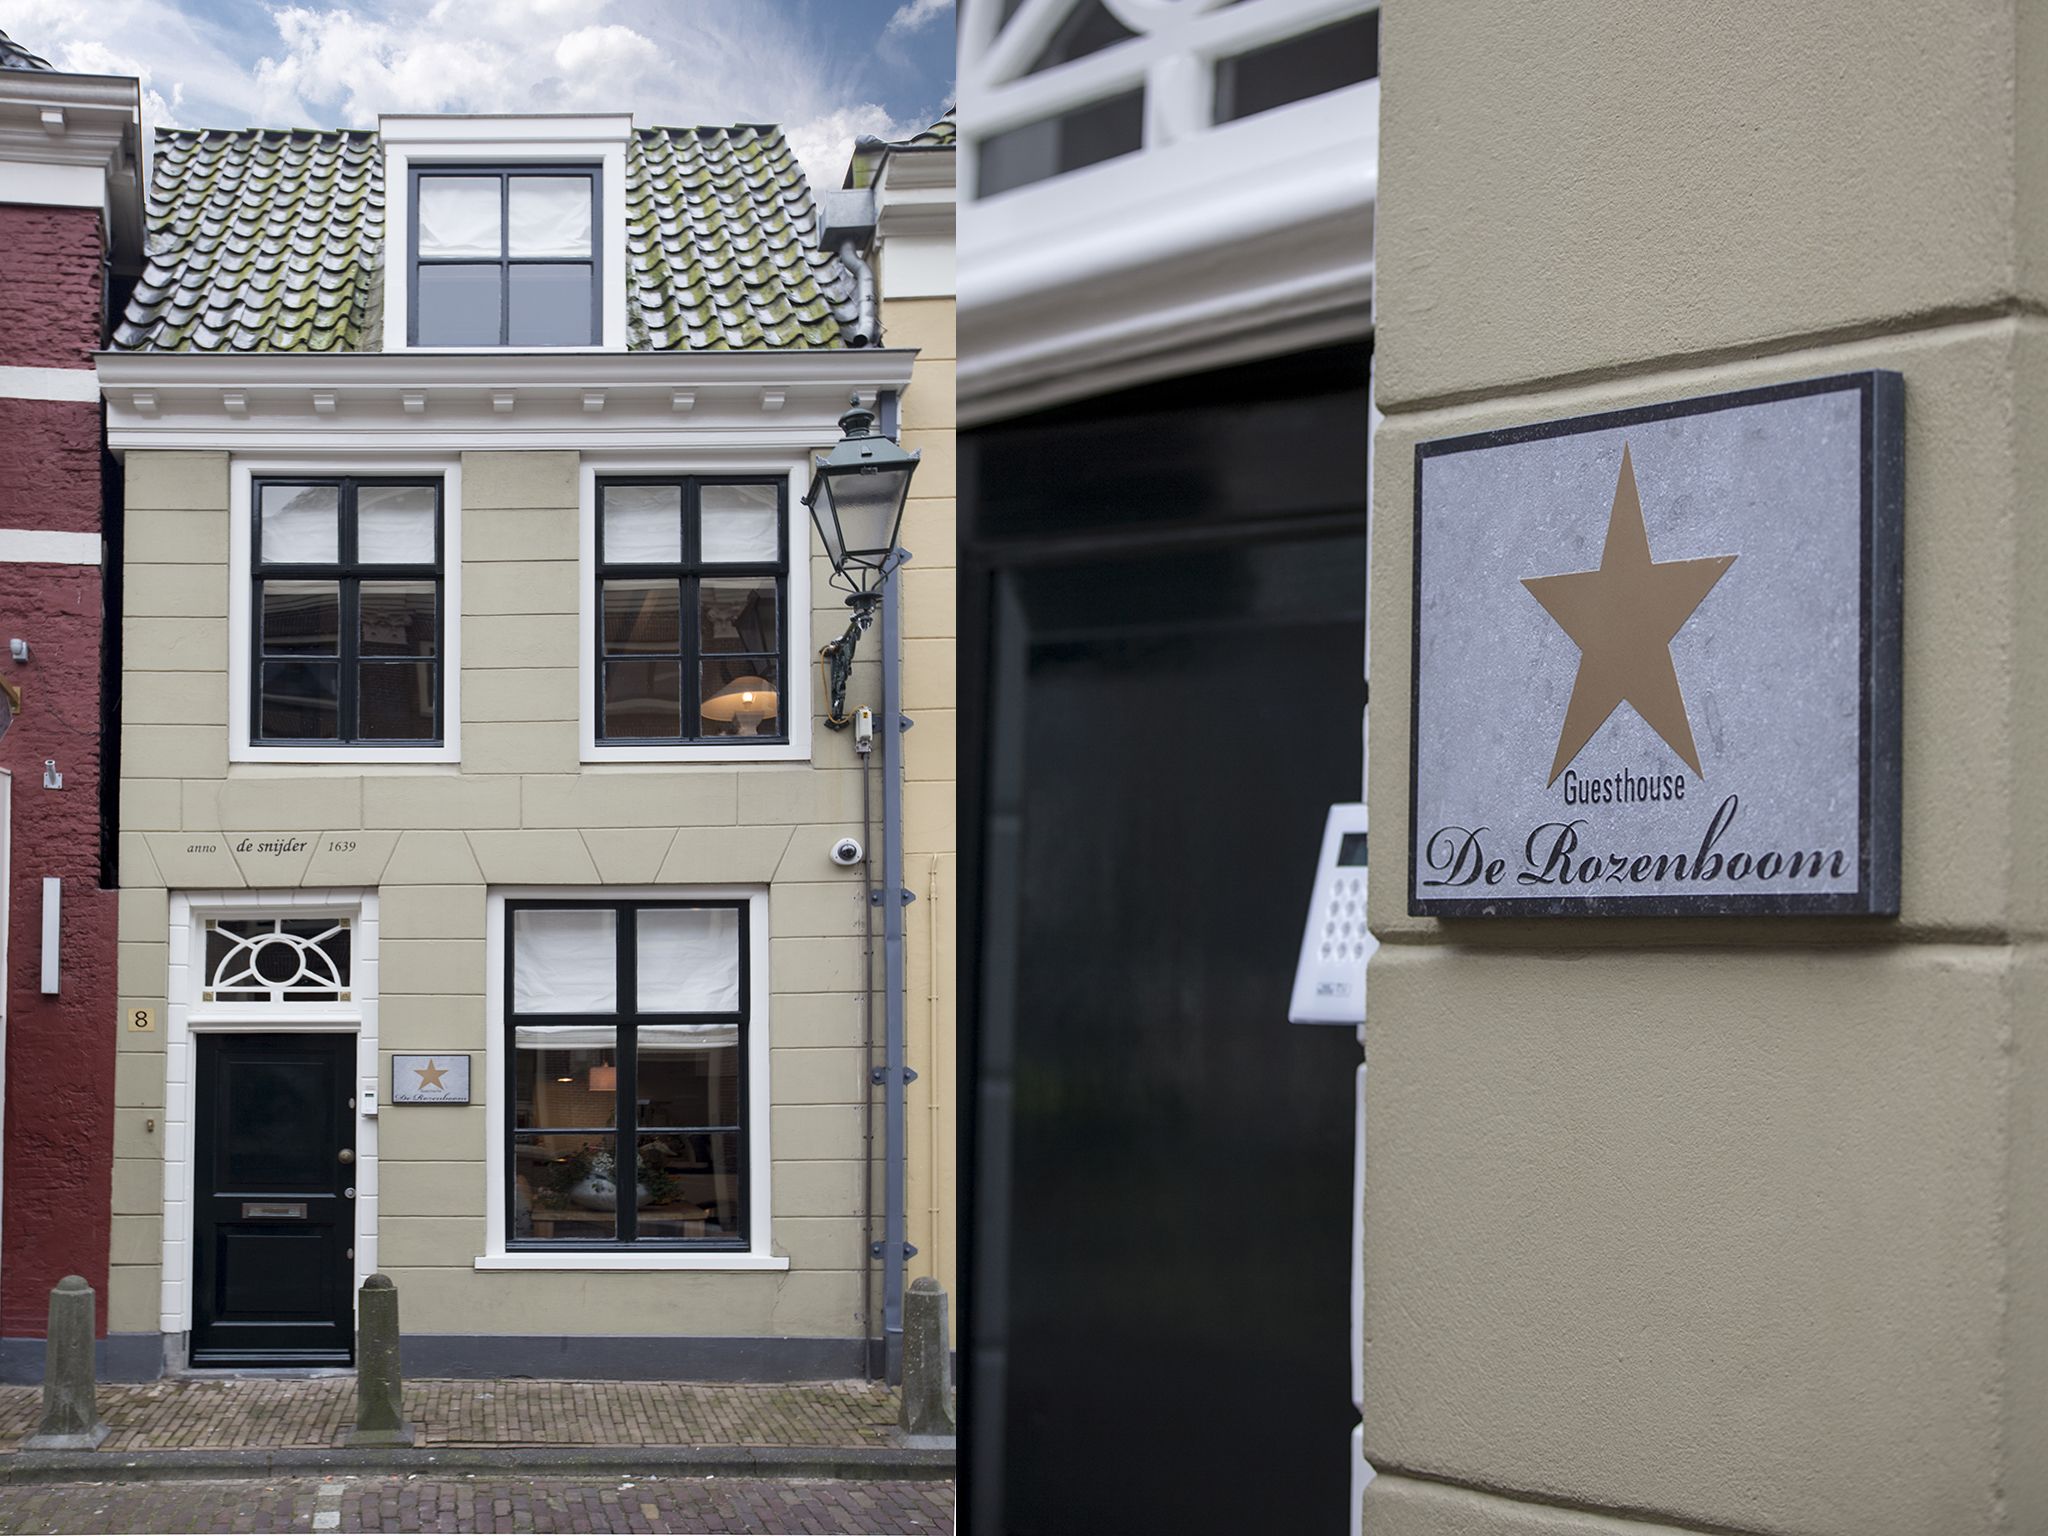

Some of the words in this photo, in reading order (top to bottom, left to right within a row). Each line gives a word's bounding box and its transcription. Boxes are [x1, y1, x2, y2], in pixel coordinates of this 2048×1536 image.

[1563, 768, 1686, 804] Guesthouse
[186, 845, 217, 853] anno
[236, 838, 253, 852] de
[257, 837, 308, 857] snijder
[328, 841, 357, 852] 1639
[1423, 825, 1506, 886] De
[1517, 794, 1848, 885] Rozenboom
[135, 1011, 148, 1028] 8
